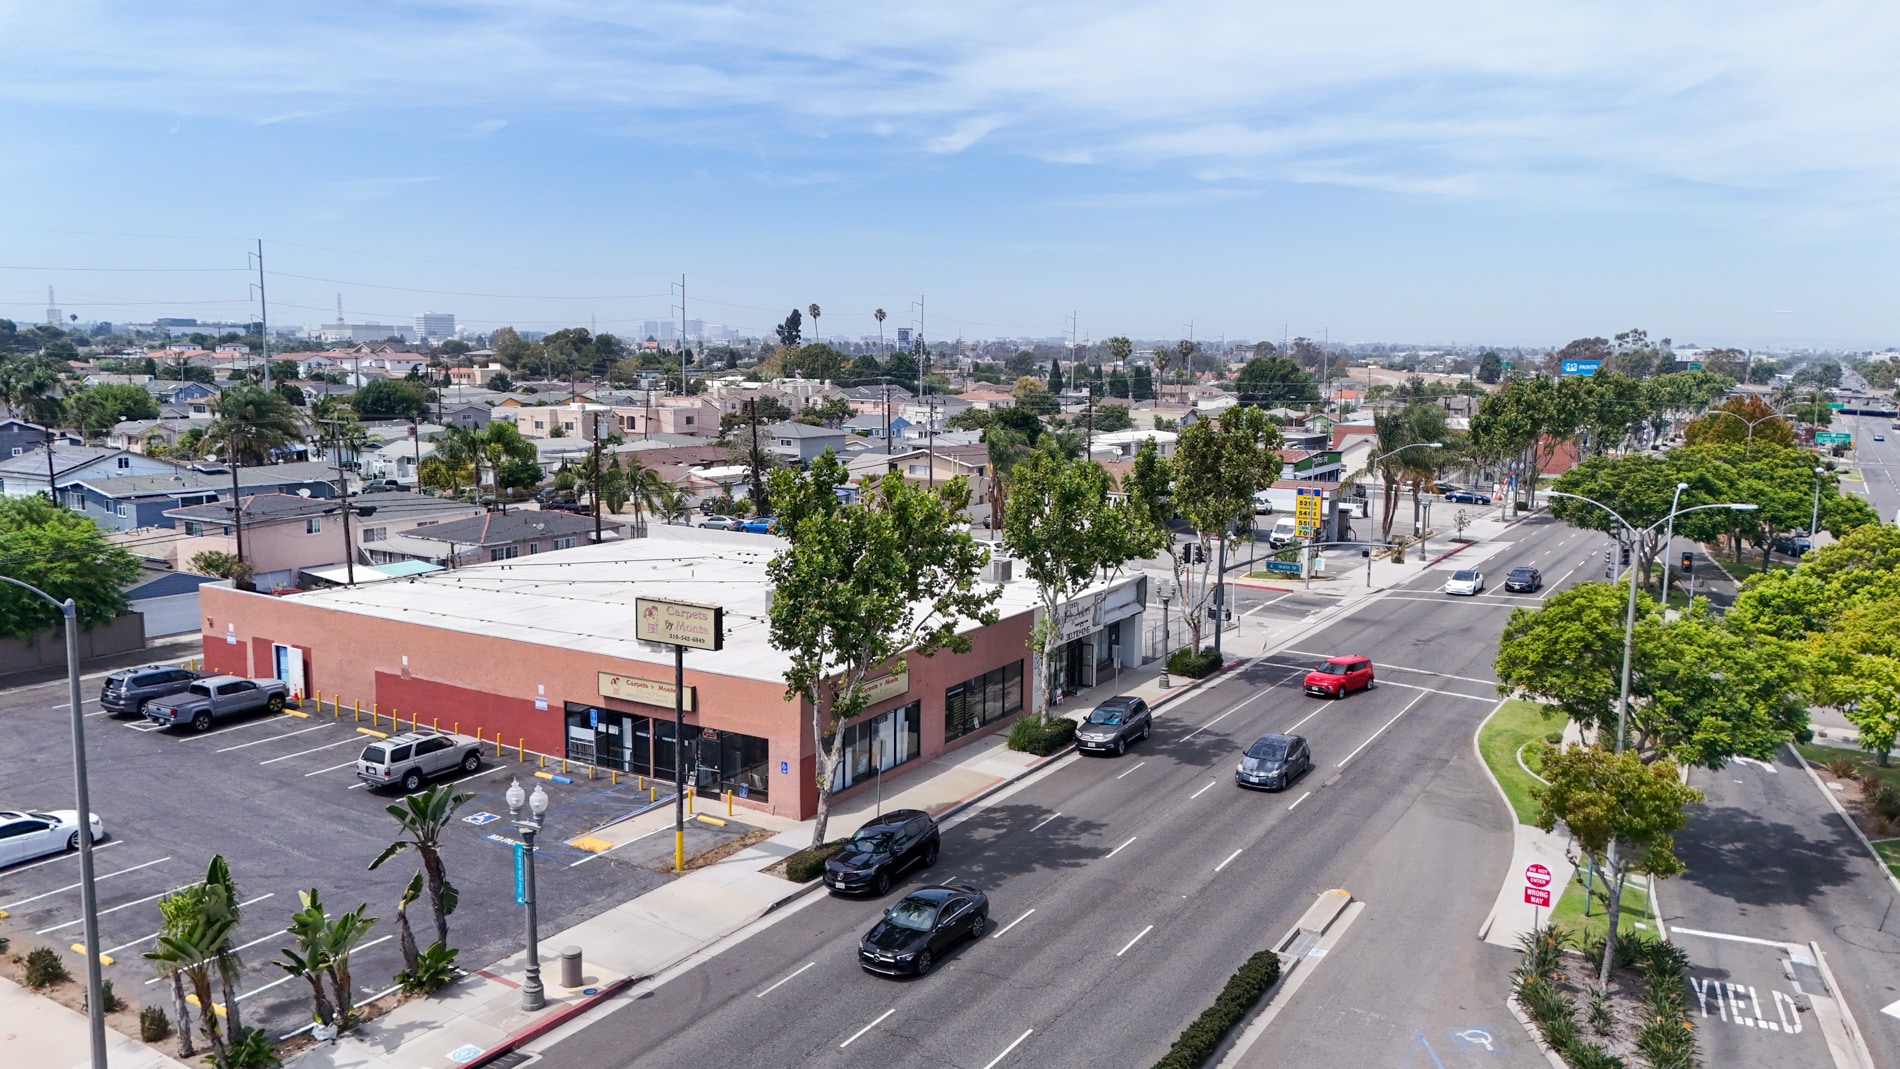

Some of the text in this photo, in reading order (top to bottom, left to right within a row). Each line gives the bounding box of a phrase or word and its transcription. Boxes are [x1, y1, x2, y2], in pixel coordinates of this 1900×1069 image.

[666, 606, 708, 620] Carpets
[675, 620, 709, 635] Monte
[626, 679, 649, 689] Carpets
[487, 833, 504, 841] NO
[1530, 877, 1546, 885] ENTER
[1527, 888, 1549, 899] WRONG
[1690, 977, 1802, 1033] YIELD
